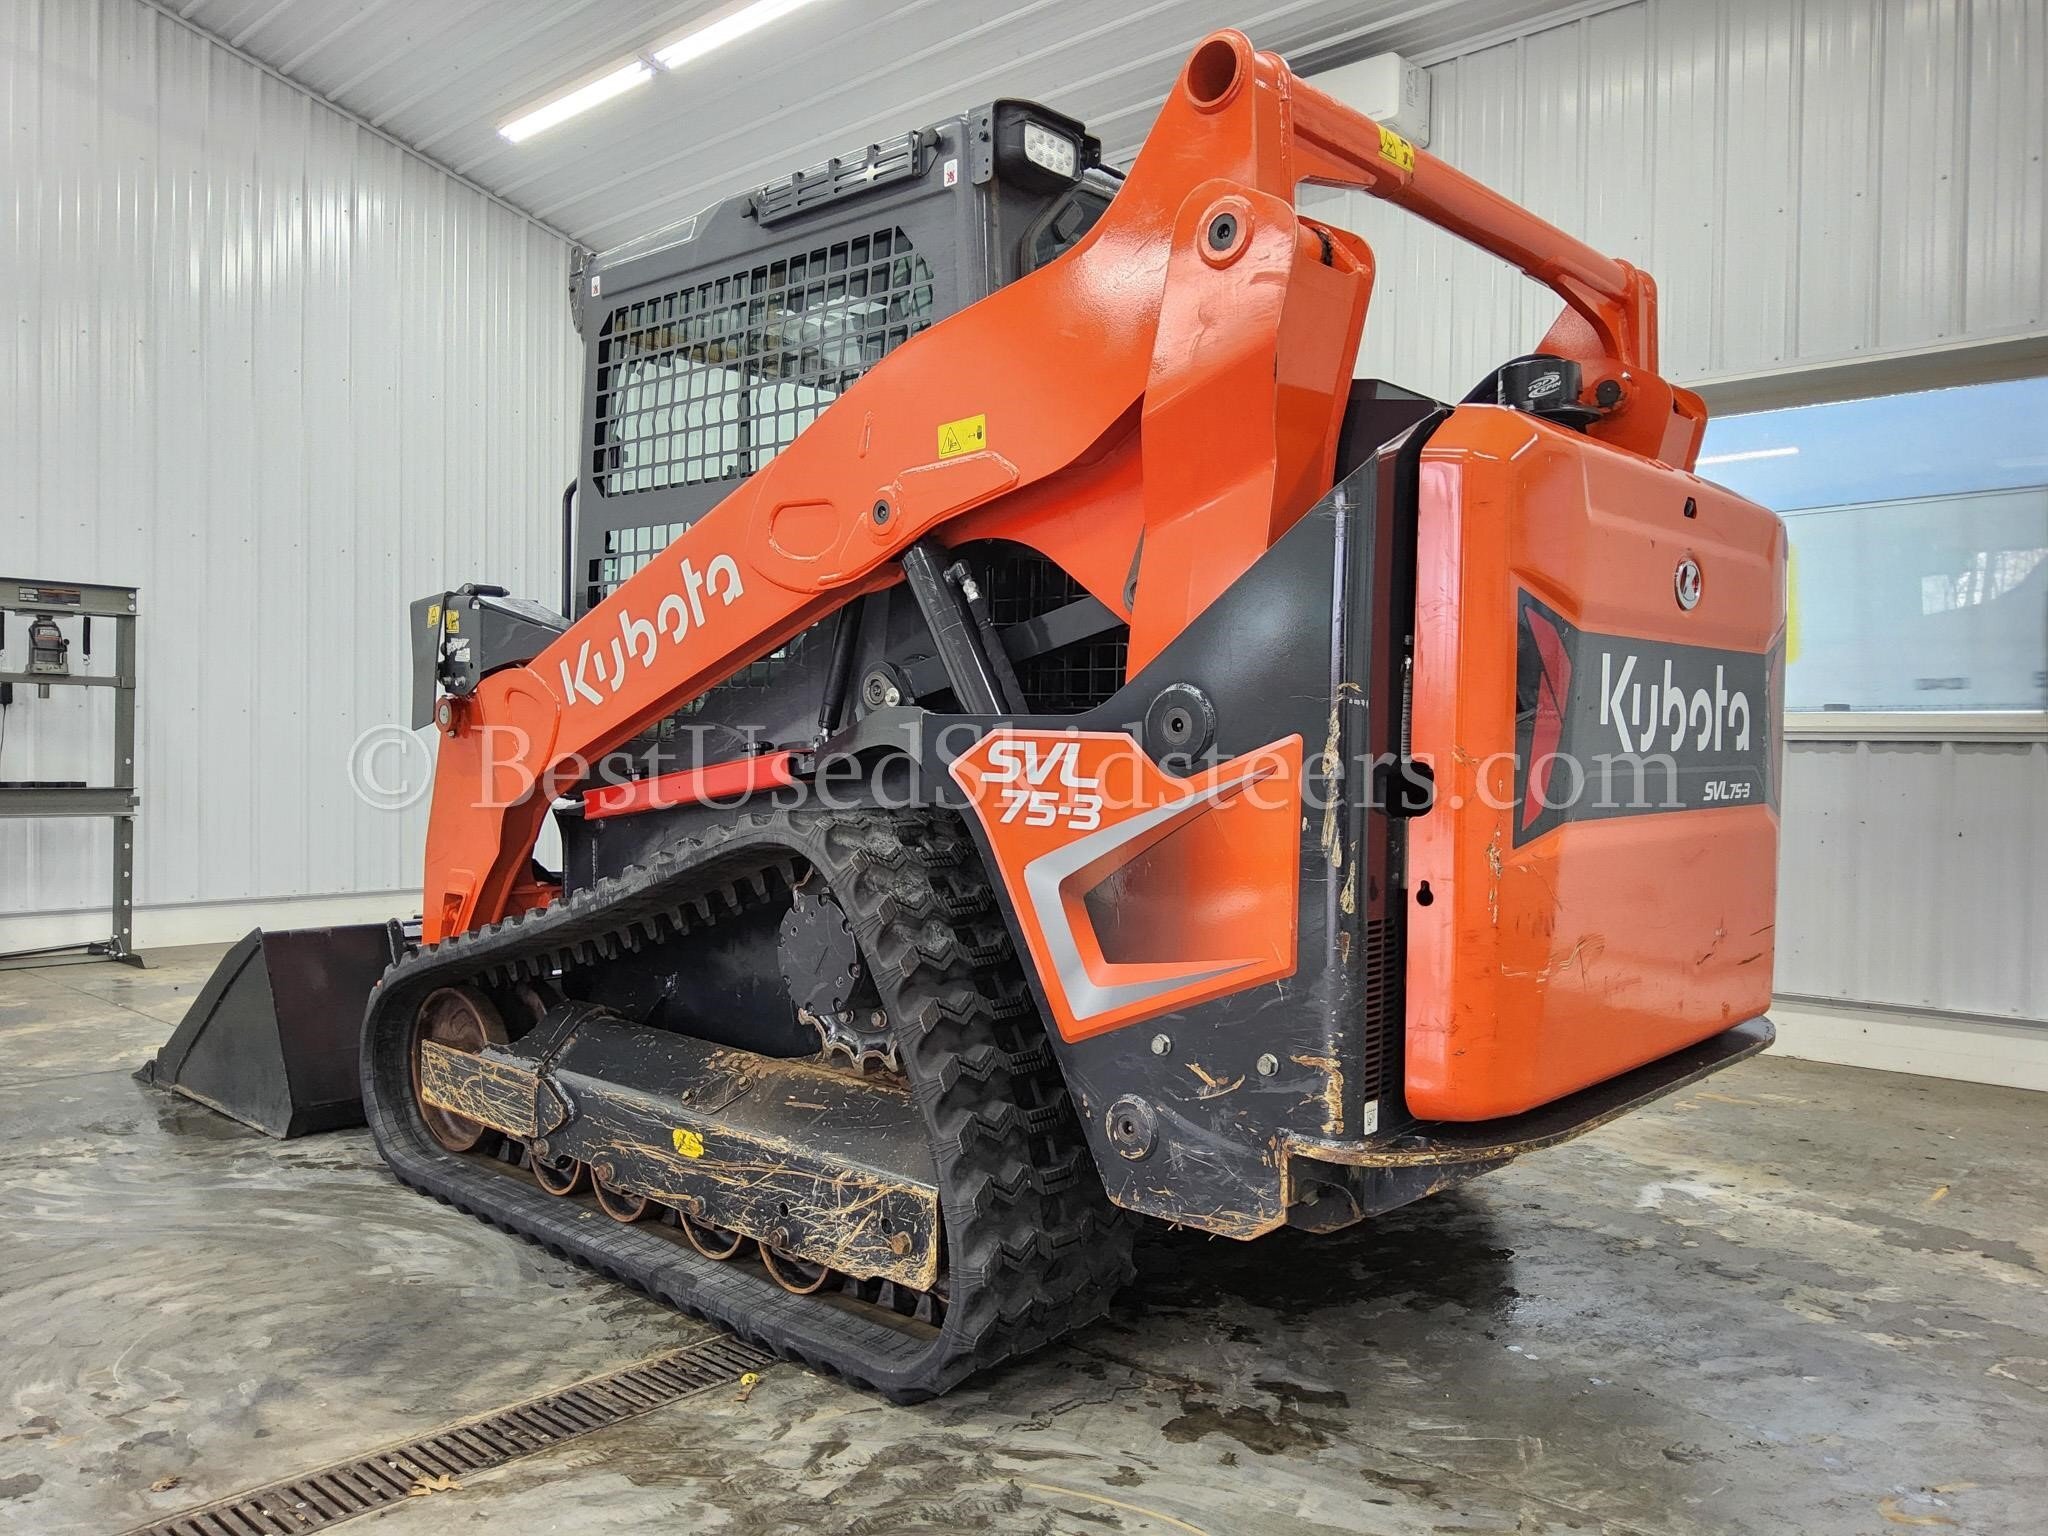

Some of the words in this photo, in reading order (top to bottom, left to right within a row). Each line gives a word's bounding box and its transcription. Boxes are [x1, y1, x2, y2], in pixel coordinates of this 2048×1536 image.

[559, 554, 744, 706] Kubota
[1600, 652, 1750, 752] Kubota
[980, 740, 1100, 789] SVL
[999, 788, 1103, 831] 75-3
